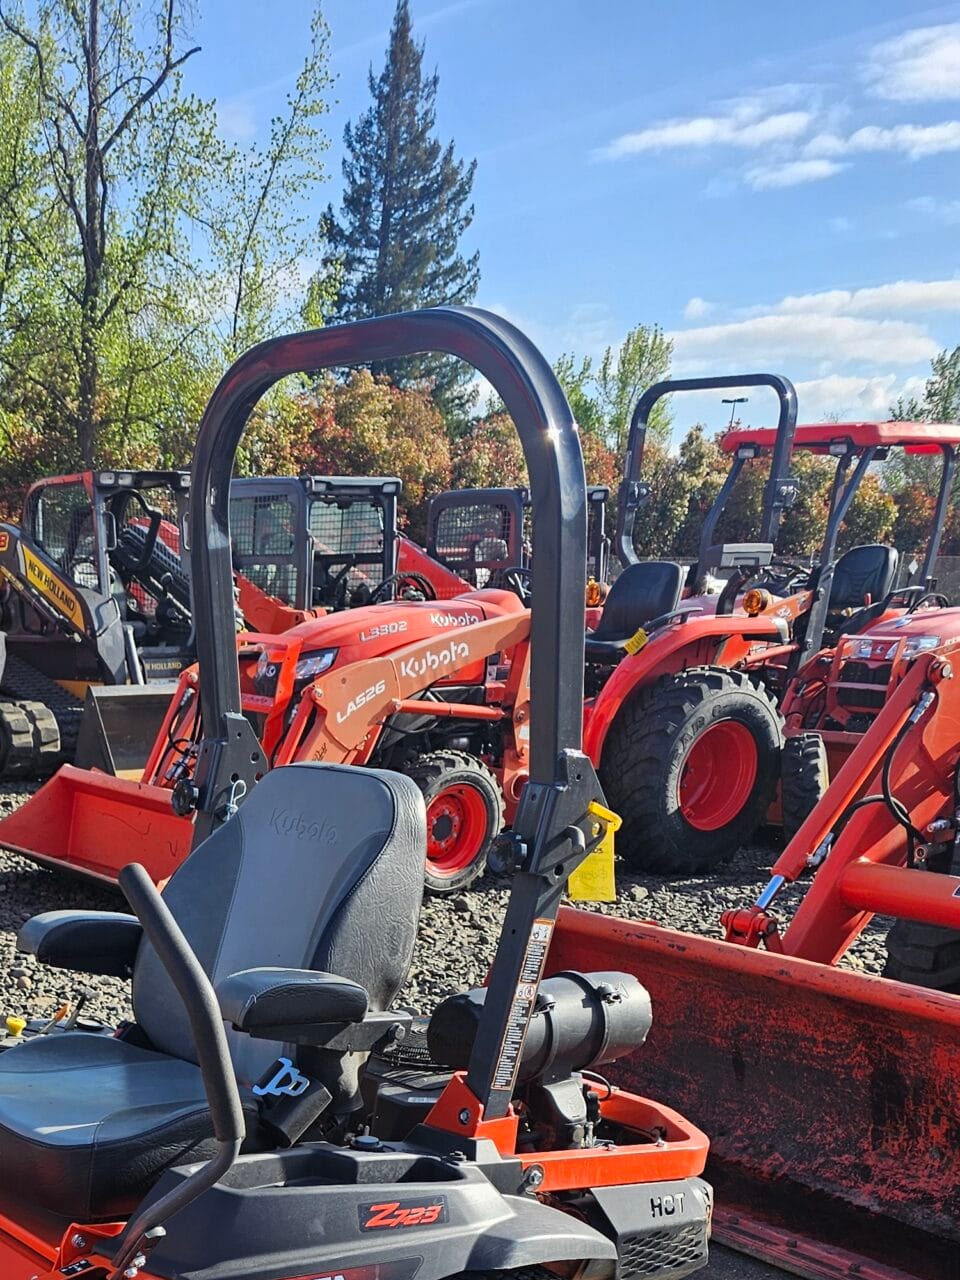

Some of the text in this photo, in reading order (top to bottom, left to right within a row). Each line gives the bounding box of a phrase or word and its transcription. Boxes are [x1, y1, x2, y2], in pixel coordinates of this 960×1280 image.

[28, 559, 75, 612] NEW HOLLAND
[359, 621, 408, 642] L3302
[430, 612, 480, 627] Kubota
[400, 641, 469, 678] Kubota
[336, 679, 386, 724] LA526
[650, 1192, 685, 1217] HOT
